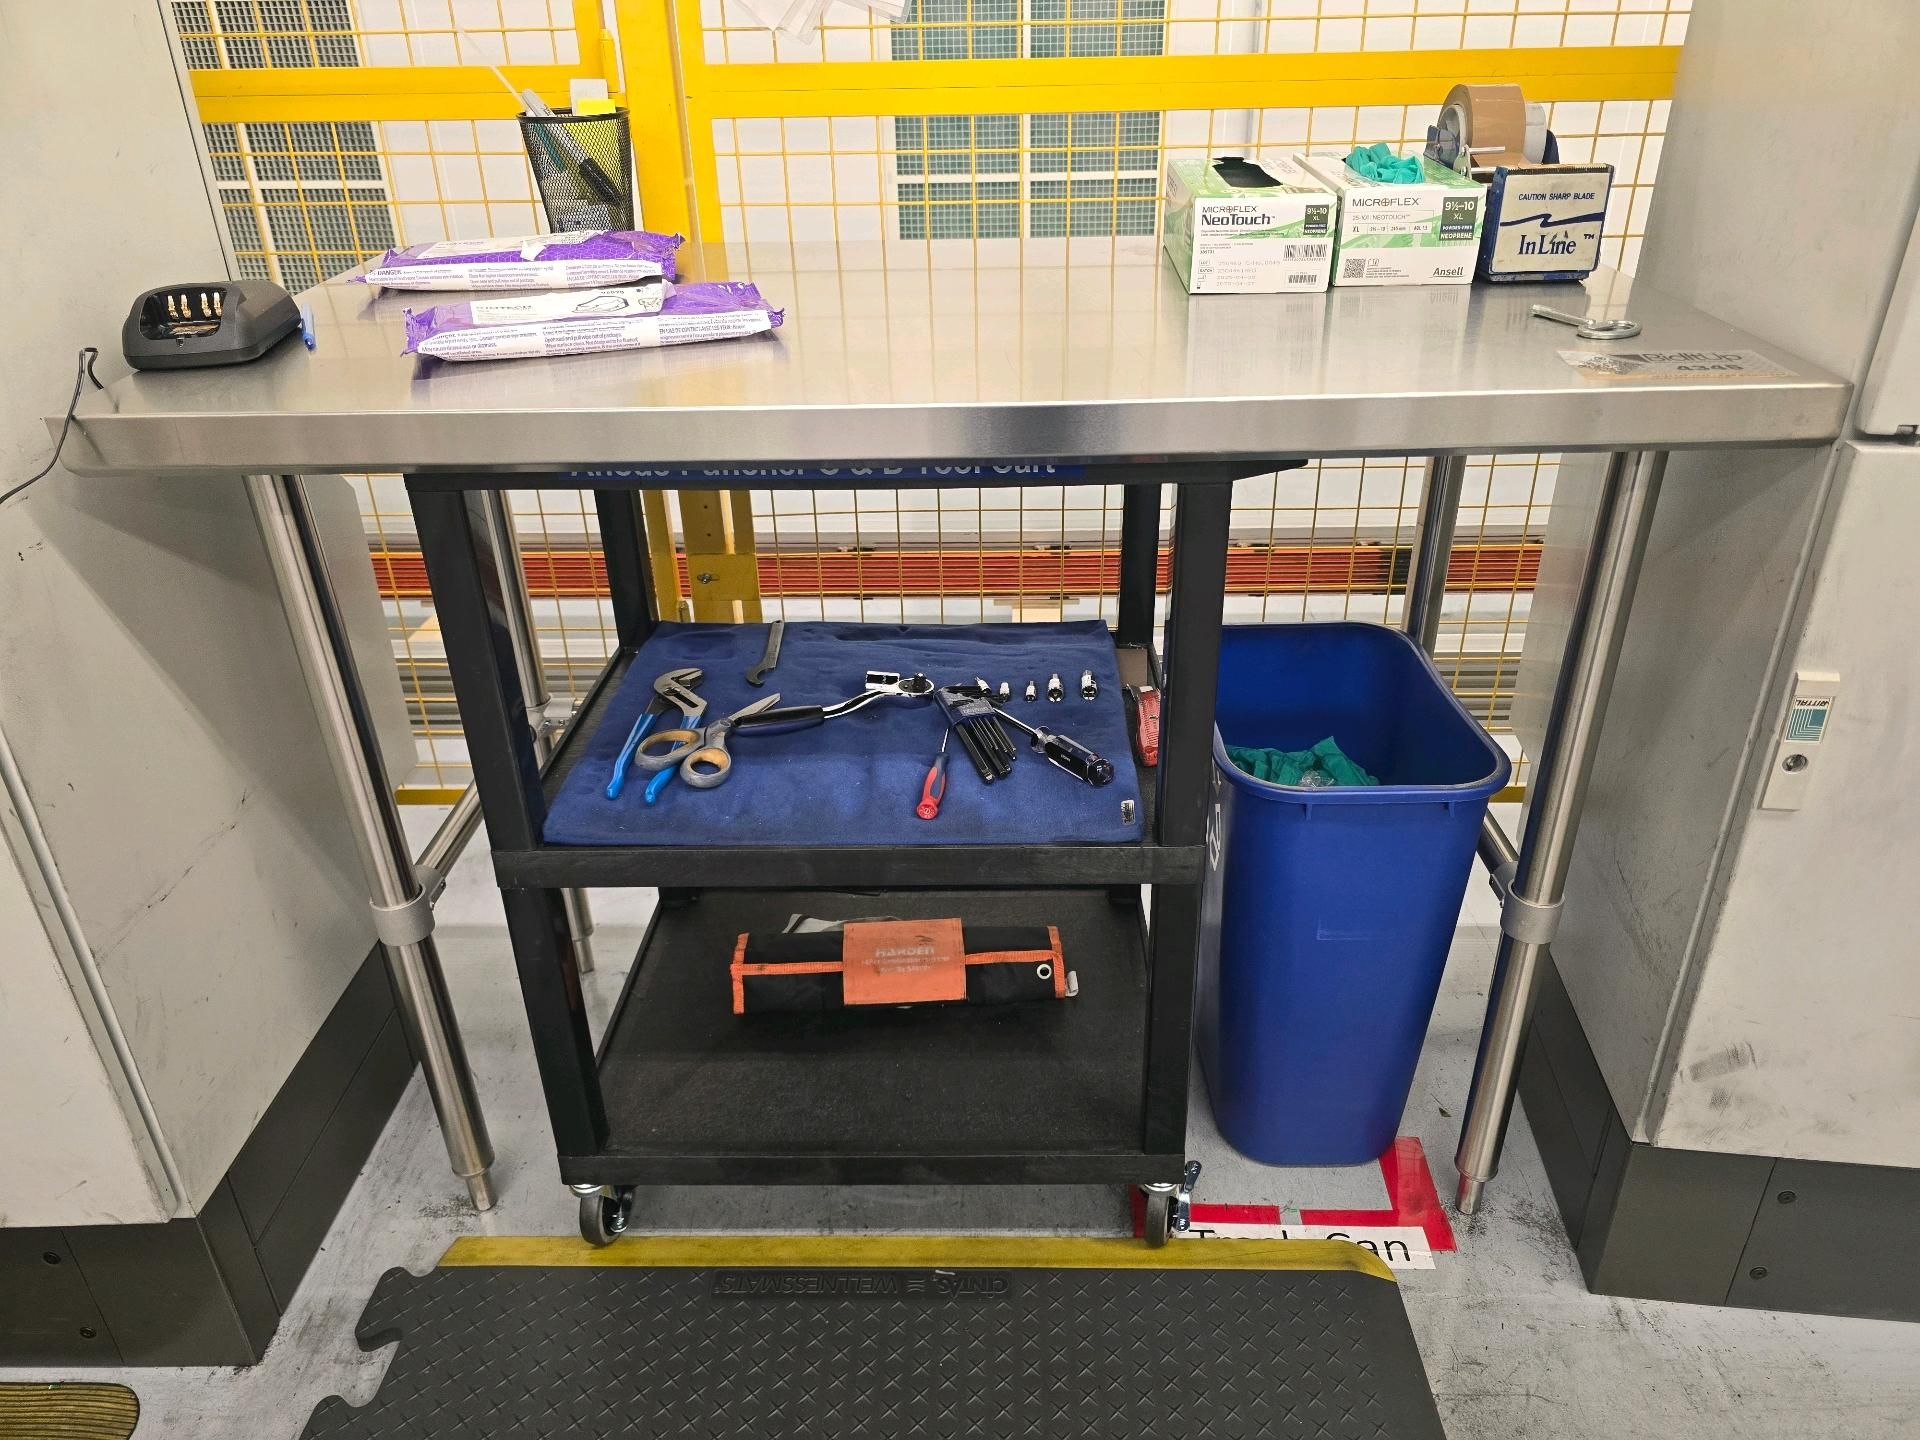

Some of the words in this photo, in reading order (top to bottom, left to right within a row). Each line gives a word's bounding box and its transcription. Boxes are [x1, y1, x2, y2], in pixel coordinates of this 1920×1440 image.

[1518, 193, 1547, 201] CAUTION
[1573, 192, 1596, 200] BLADE
[1352, 197, 1420, 207] MICROFLEX
[1352, 225, 1360, 233] XL
[1433, 266, 1464, 276] Ansell
[1795, 699, 1830, 707] RITTAL
